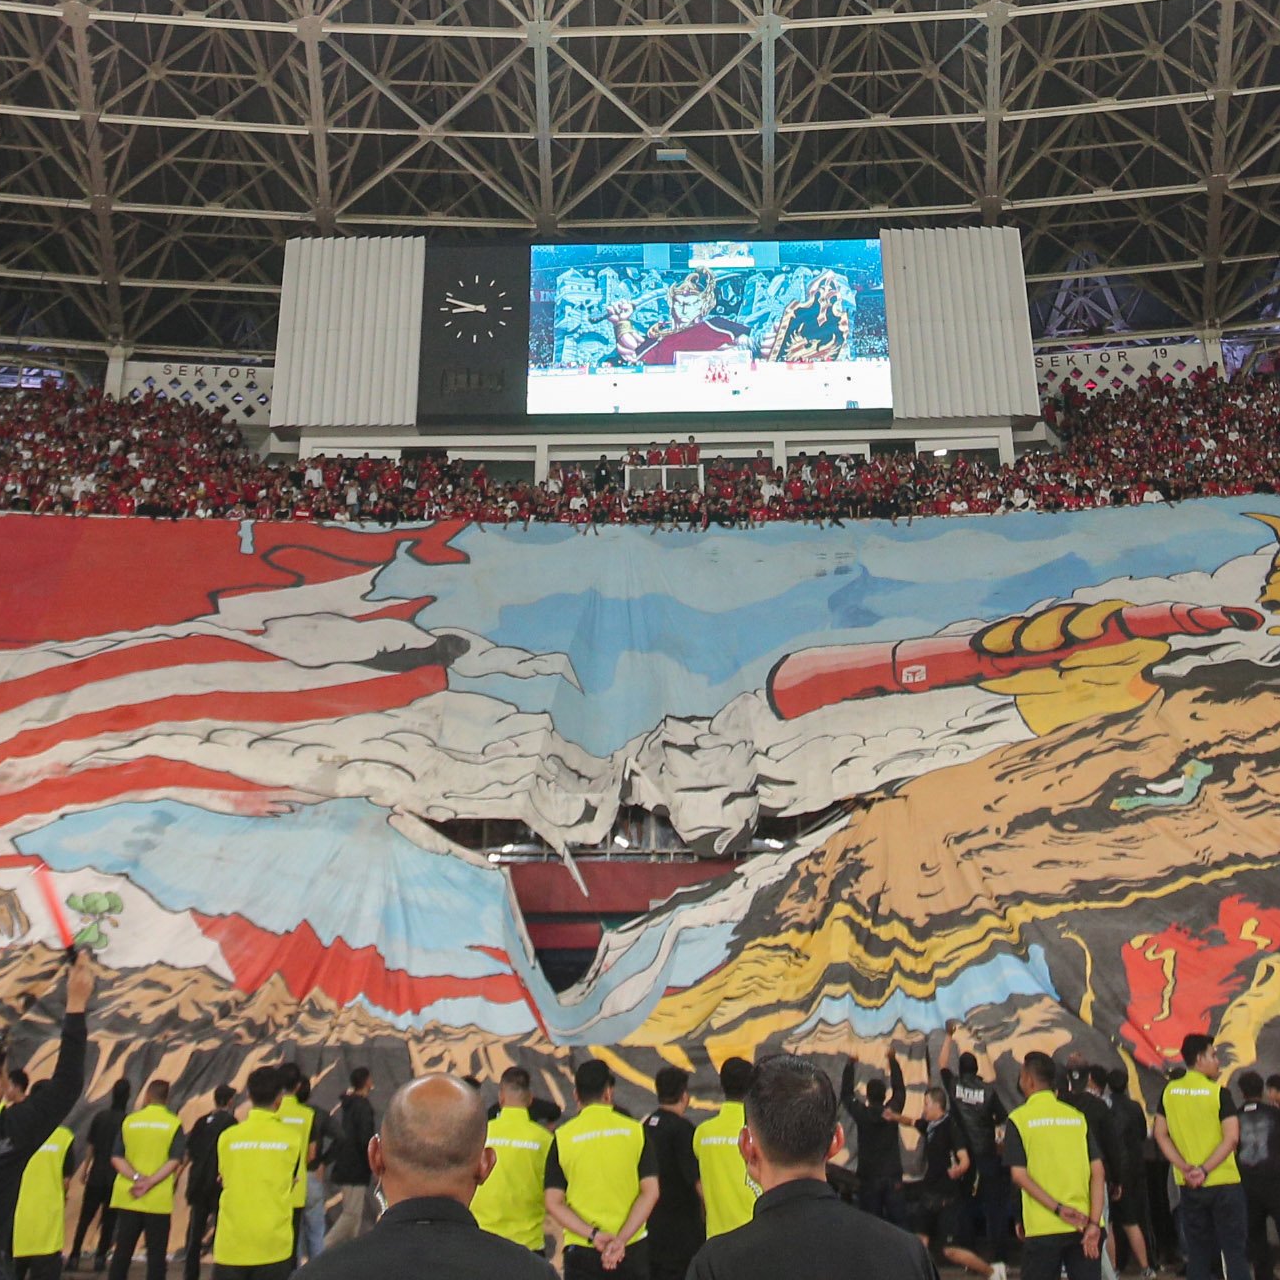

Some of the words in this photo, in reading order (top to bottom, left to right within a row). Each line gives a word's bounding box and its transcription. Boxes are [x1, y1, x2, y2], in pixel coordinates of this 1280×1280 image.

[1034, 350, 1128, 368] SEKTOR
[1152, 347, 1168, 360] 19
[162, 363, 257, 379] SEKTOR
[129, 1122, 149, 1130] SAFETY
[1028, 1118, 1054, 1128] SAFETY
[1055, 1116, 1082, 1126] GUARD
[571, 1130, 602, 1143] SAFETY
[603, 1127, 632, 1137] GUARD
[700, 1136, 727, 1145] SAFETY
[230, 1141, 258, 1151] SAFETY
[258, 1141, 290, 1151] GUARD
[512, 1138, 541, 1150] GUARD
